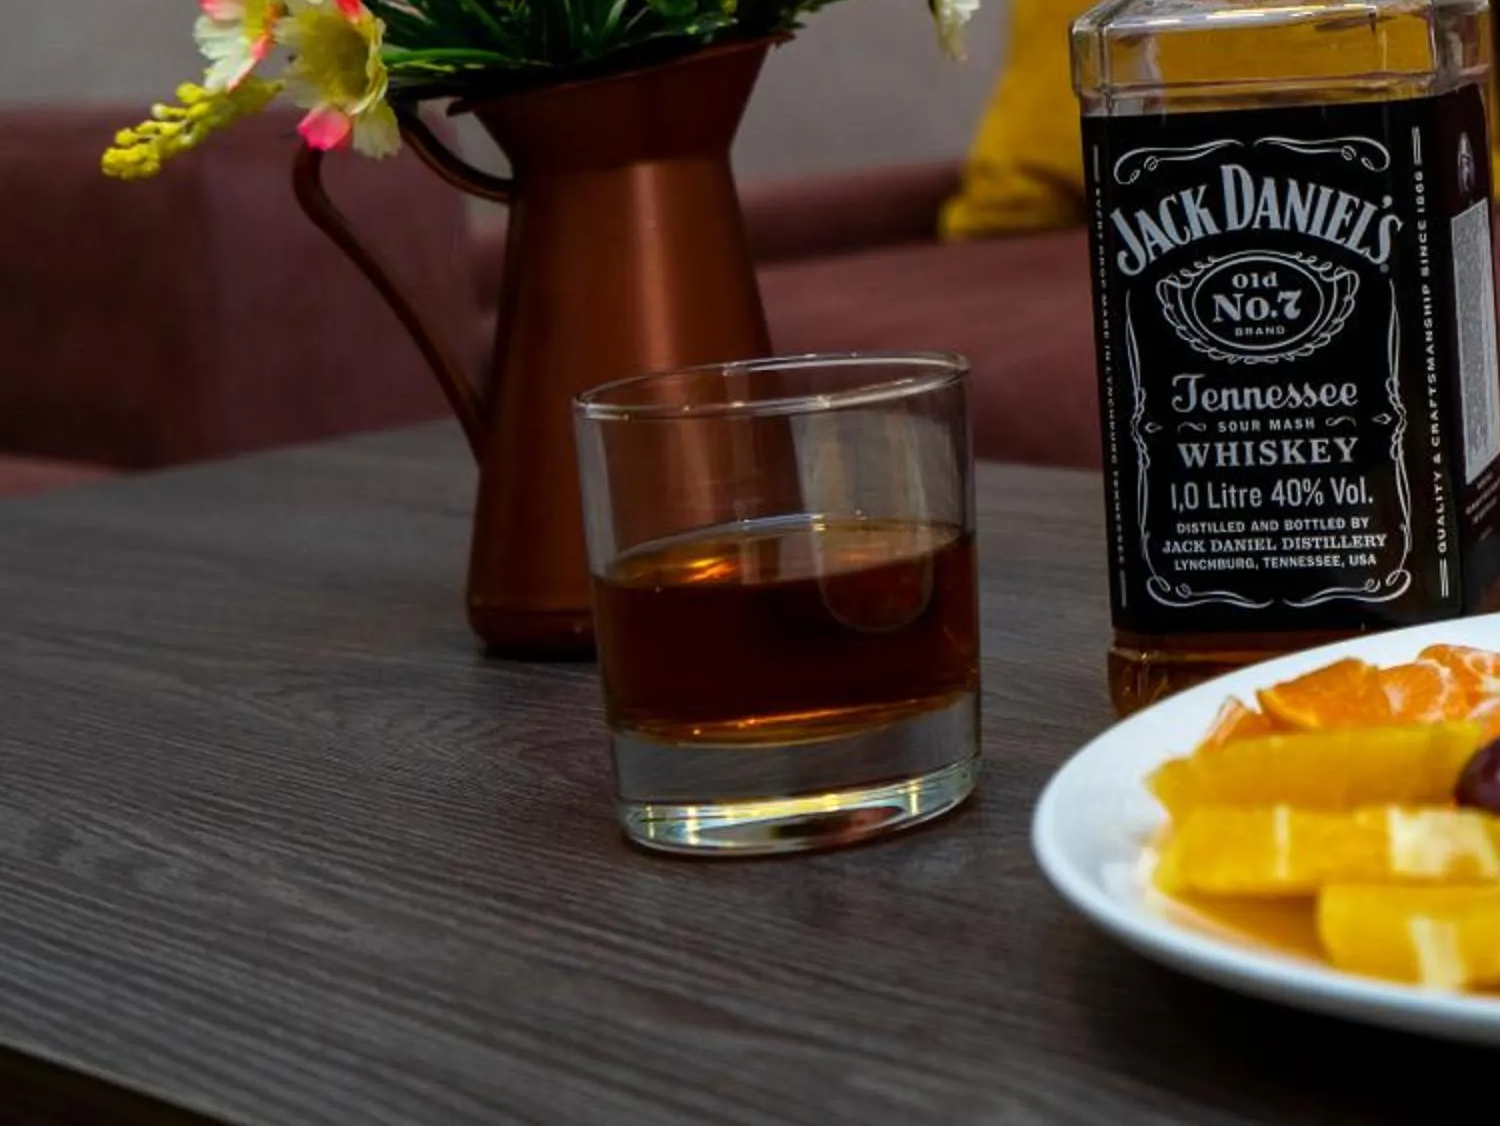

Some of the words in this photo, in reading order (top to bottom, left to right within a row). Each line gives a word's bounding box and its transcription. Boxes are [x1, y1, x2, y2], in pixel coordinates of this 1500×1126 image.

[1110, 183, 1222, 276] JACK
[1219, 163, 1404, 266] DANIEL'S
[1417, 220, 1429, 277] SINCE
[1232, 272, 1277, 288] old
[1235, 326, 1284, 336] BRAND
[1420, 283, 1440, 447] CRAFTSMANSHIP
[1172, 374, 1358, 412] Tennessee
[1218, 420, 1260, 432] SOUR
[1270, 418, 1314, 430] MASH
[1178, 437, 1358, 467] WHISKEY
[1171, 482, 1198, 512] 1,0
[1208, 482, 1262, 508] Litre
[1271, 478, 1324, 506] 40%
[1330, 476, 1373, 504] Vol.
[1177, 522, 1245, 533] DISTILLED
[1251, 520, 1279, 531] AND
[1284, 517, 1346, 531] BOTTLED
[1351, 517, 1369, 529] BY
[1434, 471, 1447, 553] QUALITY
[1163, 540, 1206, 553] JACK
[1210, 538, 1276, 552] DANIEL
[1282, 534, 1387, 550] DISTILLERY
[1175, 558, 1258, 570] LYNCHBURG,
[1262, 555, 1344, 568] TENNESSEE,
[1349, 553, 1376, 566] USA
